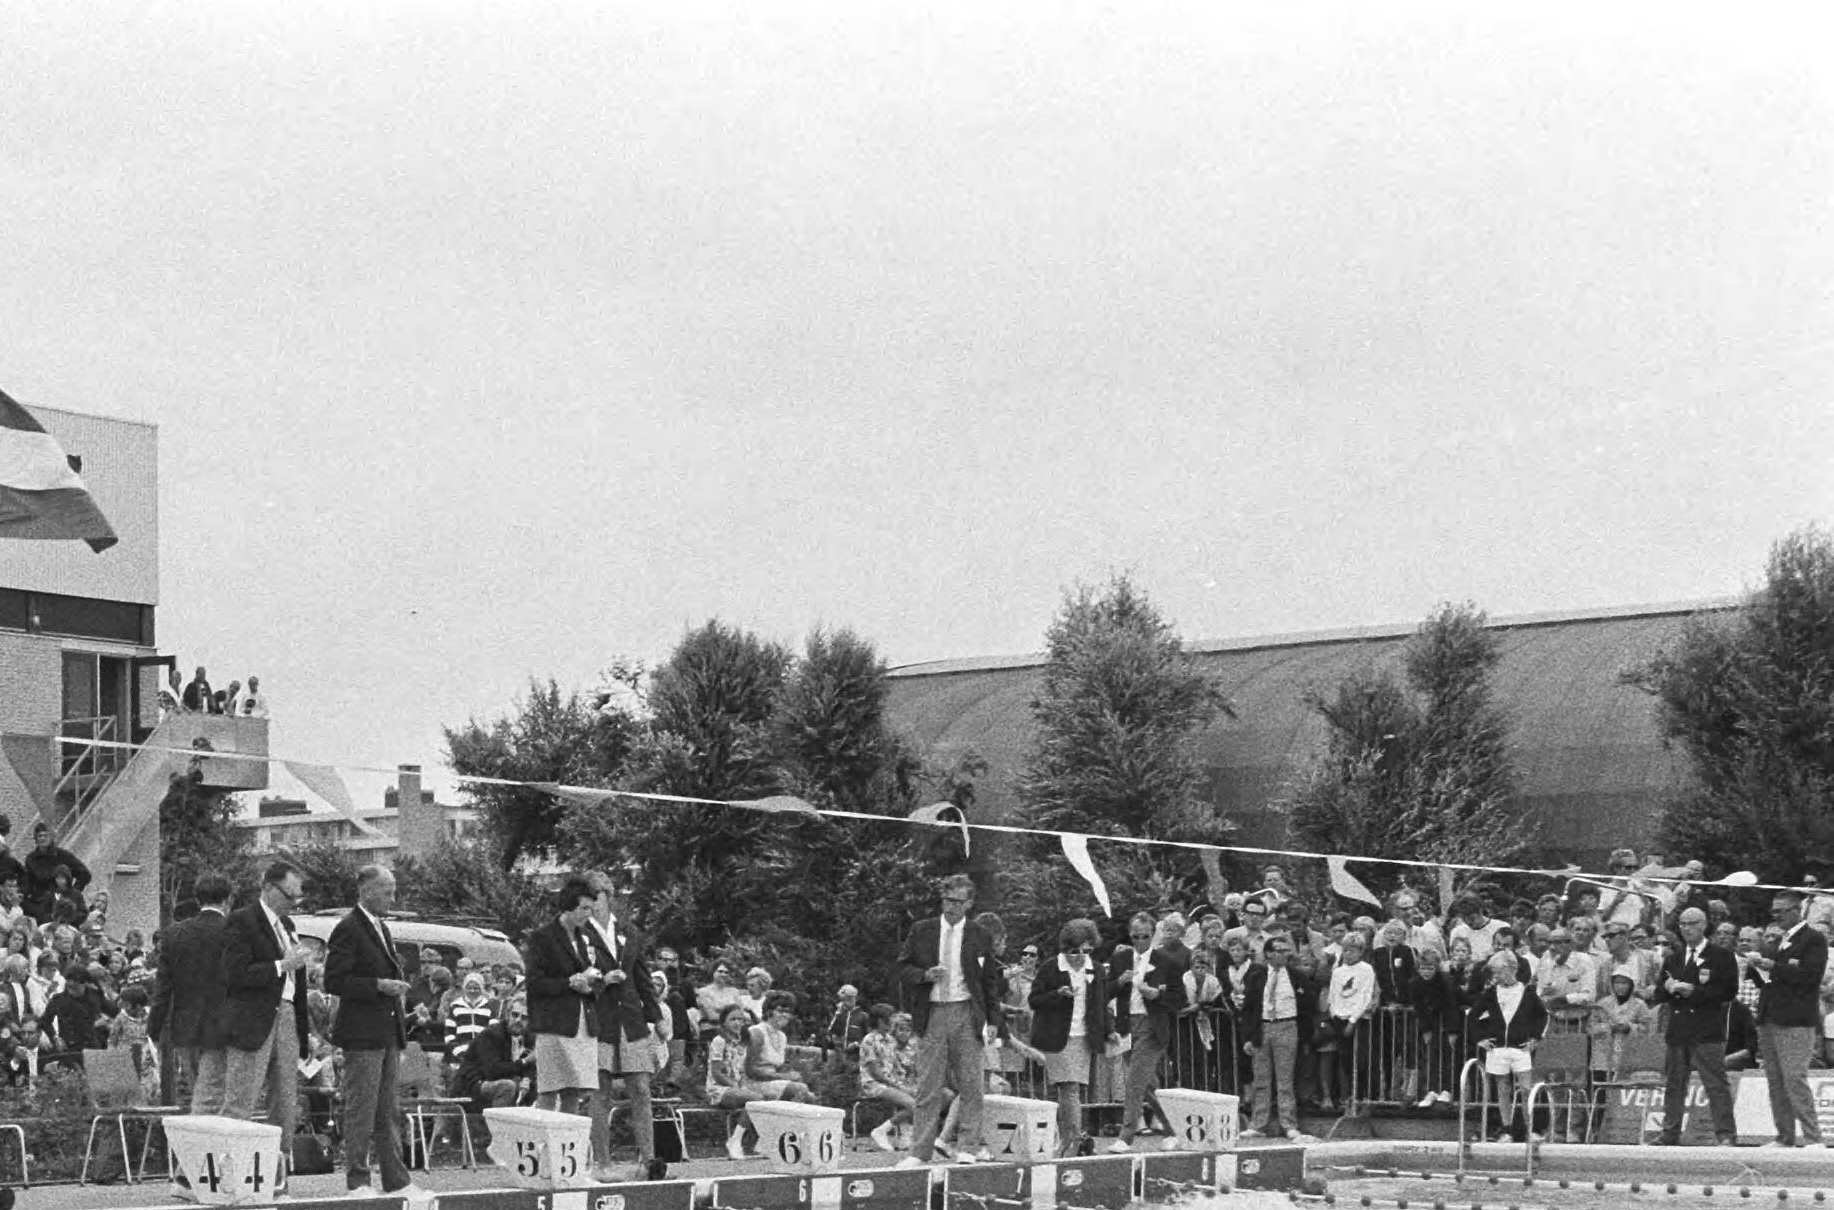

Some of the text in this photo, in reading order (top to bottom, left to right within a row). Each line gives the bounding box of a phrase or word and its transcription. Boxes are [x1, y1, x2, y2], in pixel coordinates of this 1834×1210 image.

[997, 1122, 1018, 1153] 7
[1186, 1114, 1206, 1142] 8
[1220, 1114, 1231, 1142] 8
[517, 1140, 540, 1177] 5
[560, 1141, 577, 1178] 5
[778, 1131, 802, 1164] 6
[819, 1130, 833, 1163] 6
[198, 1152, 221, 1193] 4
[244, 1151, 265, 1193] 4
[798, 1179, 807, 1202] 6
